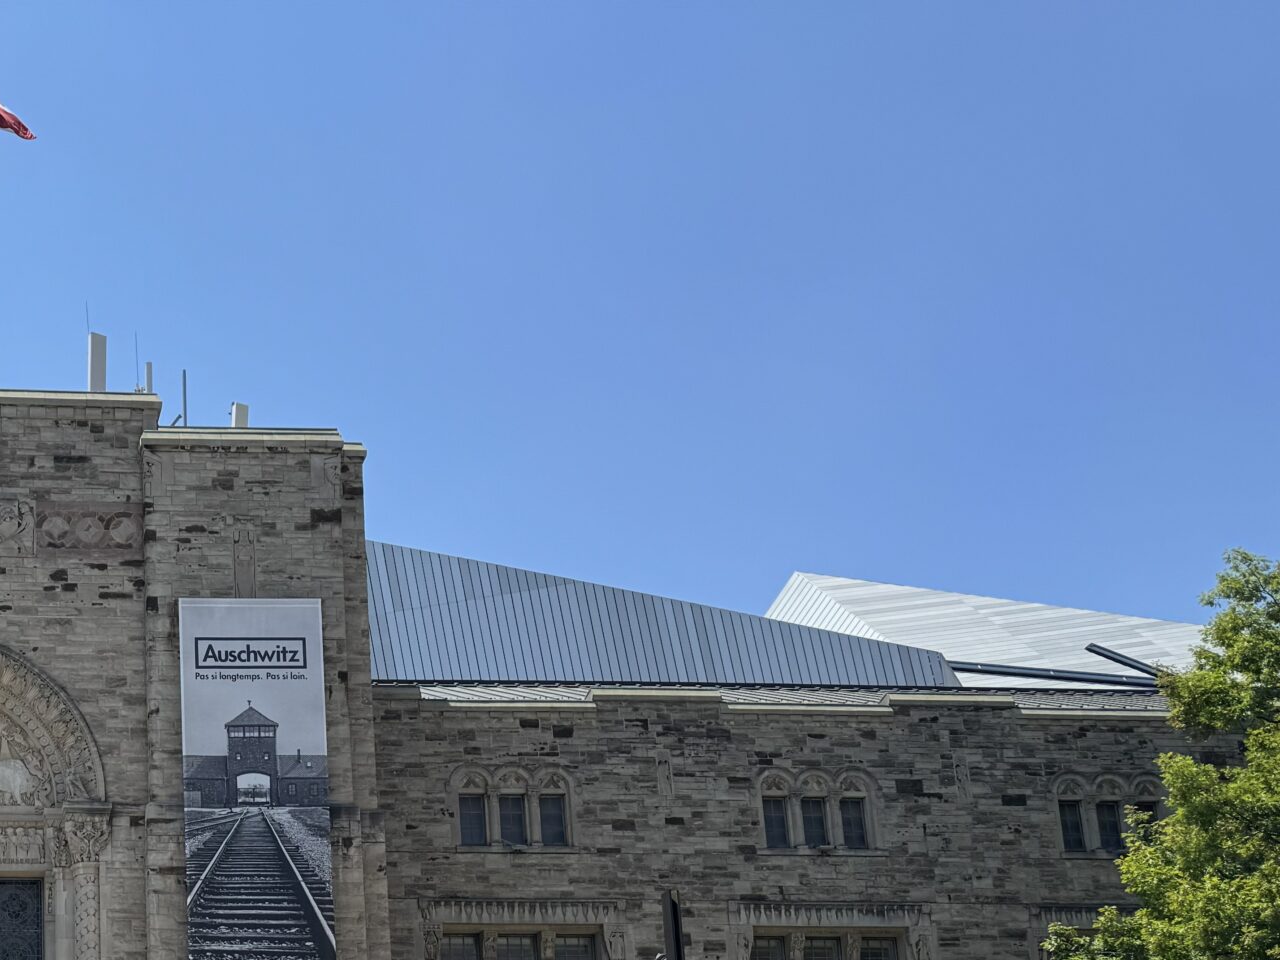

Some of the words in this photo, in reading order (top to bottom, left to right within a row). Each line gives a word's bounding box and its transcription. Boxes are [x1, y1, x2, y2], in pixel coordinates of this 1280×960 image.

[202, 644, 300, 663] Auschwitz
[195, 672, 209, 680] Pas
[211, 672, 218, 680] si
[219, 672, 263, 682] longtemps.
[266, 672, 280, 680] Pas
[282, 672, 289, 680] si
[290, 672, 308, 680] loin.
